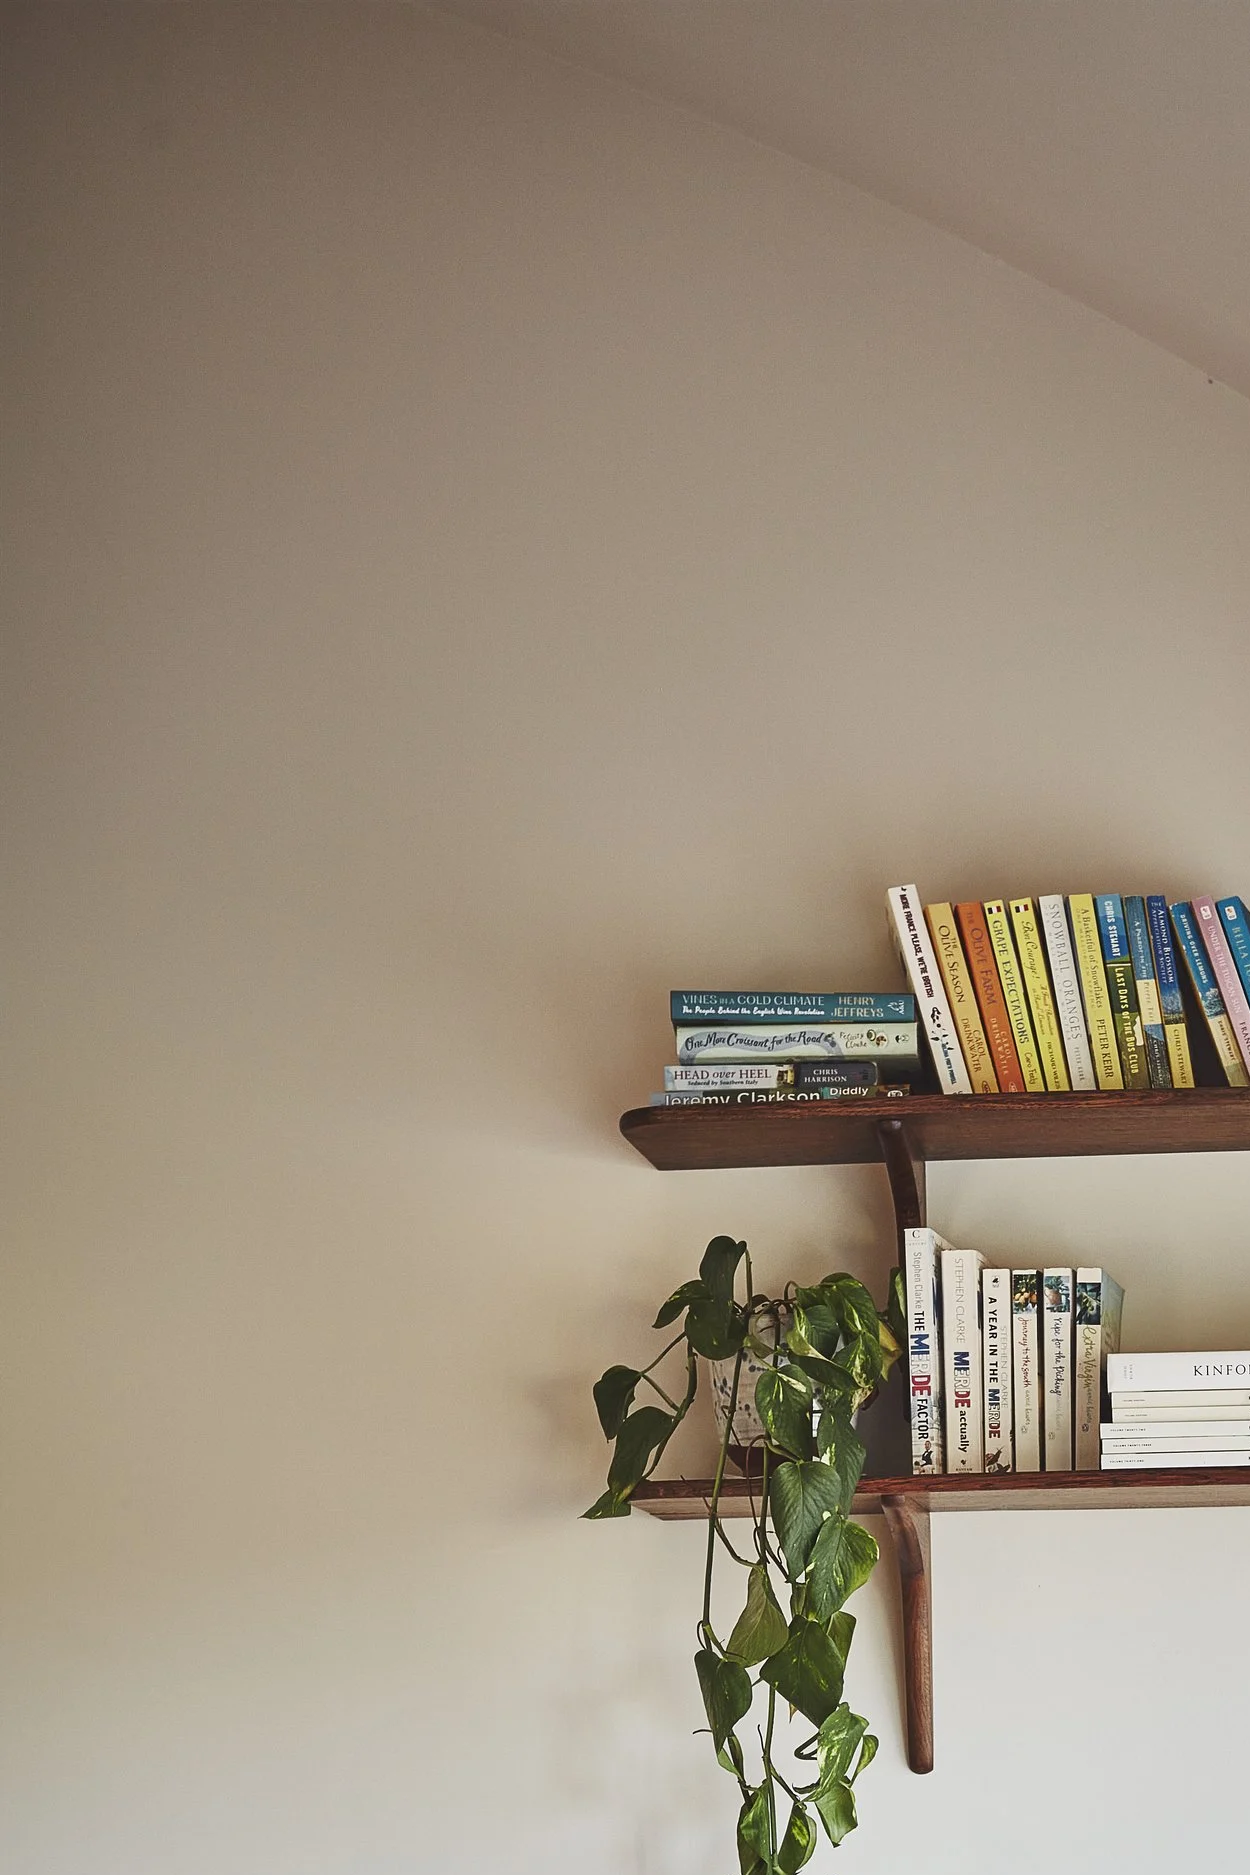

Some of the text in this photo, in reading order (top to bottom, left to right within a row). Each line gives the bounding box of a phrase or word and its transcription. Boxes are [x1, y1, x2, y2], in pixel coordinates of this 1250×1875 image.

[1104, 901, 1121, 957] CHRIS STEWART
[1158, 909, 1175, 983] ALMOND BLOSSOM
[1180, 914, 1209, 984] DRIVING OVER LEMONS
[1231, 926, 1249, 959] BELLA
[939, 925, 965, 1003] OLIVE SEASON
[971, 928, 997, 1005] OLIVE FARM
[993, 920, 1029, 1044] GRAPE EXPECTATIONS
[1049, 903, 1069, 973] SNOWBALL
[1063, 979, 1082, 1040] ORANGES
[1083, 917, 1104, 1008] Basketful Snowflakes
[683, 994, 825, 1005] VINES COLD CLIMATE
[695, 1006, 716, 1015] People
[753, 1007, 775, 1016] English
[794, 1007, 825, 1015] Revolution
[833, 1008, 884, 1017] JEFFREYS
[839, 996, 875, 1005] HENRY
[1114, 967, 1139, 1074] LAST DAYS OF THE BUS CLUB
[685, 1031, 824, 1051] One More Croissant for the Road
[962, 1018, 982, 1073] DRINKWATER
[973, 1029, 986, 1057] CAROL
[1096, 1019, 1115, 1078] PETER KERR
[1173, 1028, 1182, 1051] CHRIS
[674, 1069, 771, 1079] HEAD over HEEL
[737, 1091, 820, 1102] Clarkson
[829, 1087, 868, 1097] Diddly
[912, 1252, 923, 1309] Stephen Clarke
[954, 1258, 966, 1343] STEPHEN CLARKE
[910, 1310, 932, 1440] THE MERDE FACTOR
[988, 1296, 1001, 1439] A YEAR IN THE MERDE
[1000, 1326, 1009, 1409] STEPHEN CLARKE
[953, 1351, 971, 1453] MERDE actually
